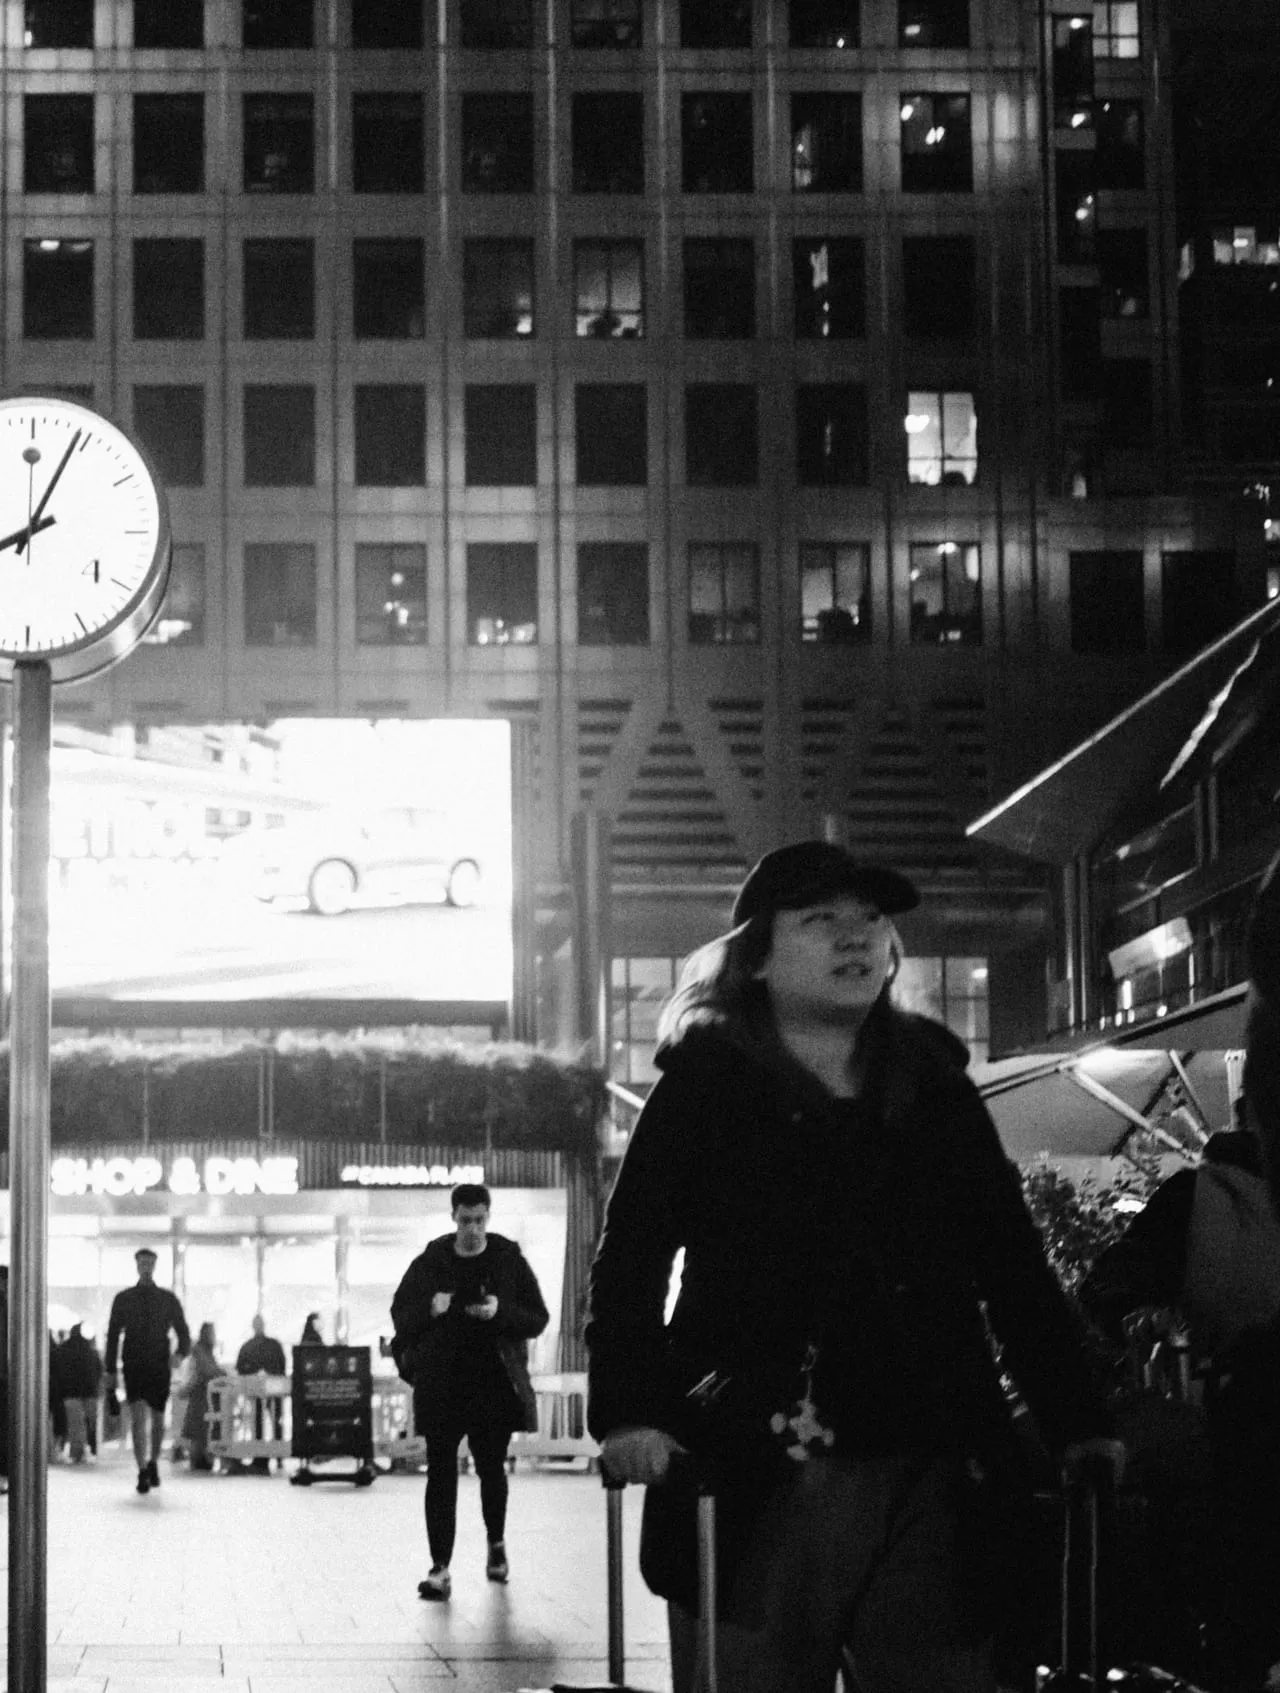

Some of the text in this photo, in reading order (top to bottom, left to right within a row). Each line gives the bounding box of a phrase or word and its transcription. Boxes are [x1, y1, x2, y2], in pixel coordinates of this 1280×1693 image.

[51, 1157, 297, 1195] SHOP & DINE
